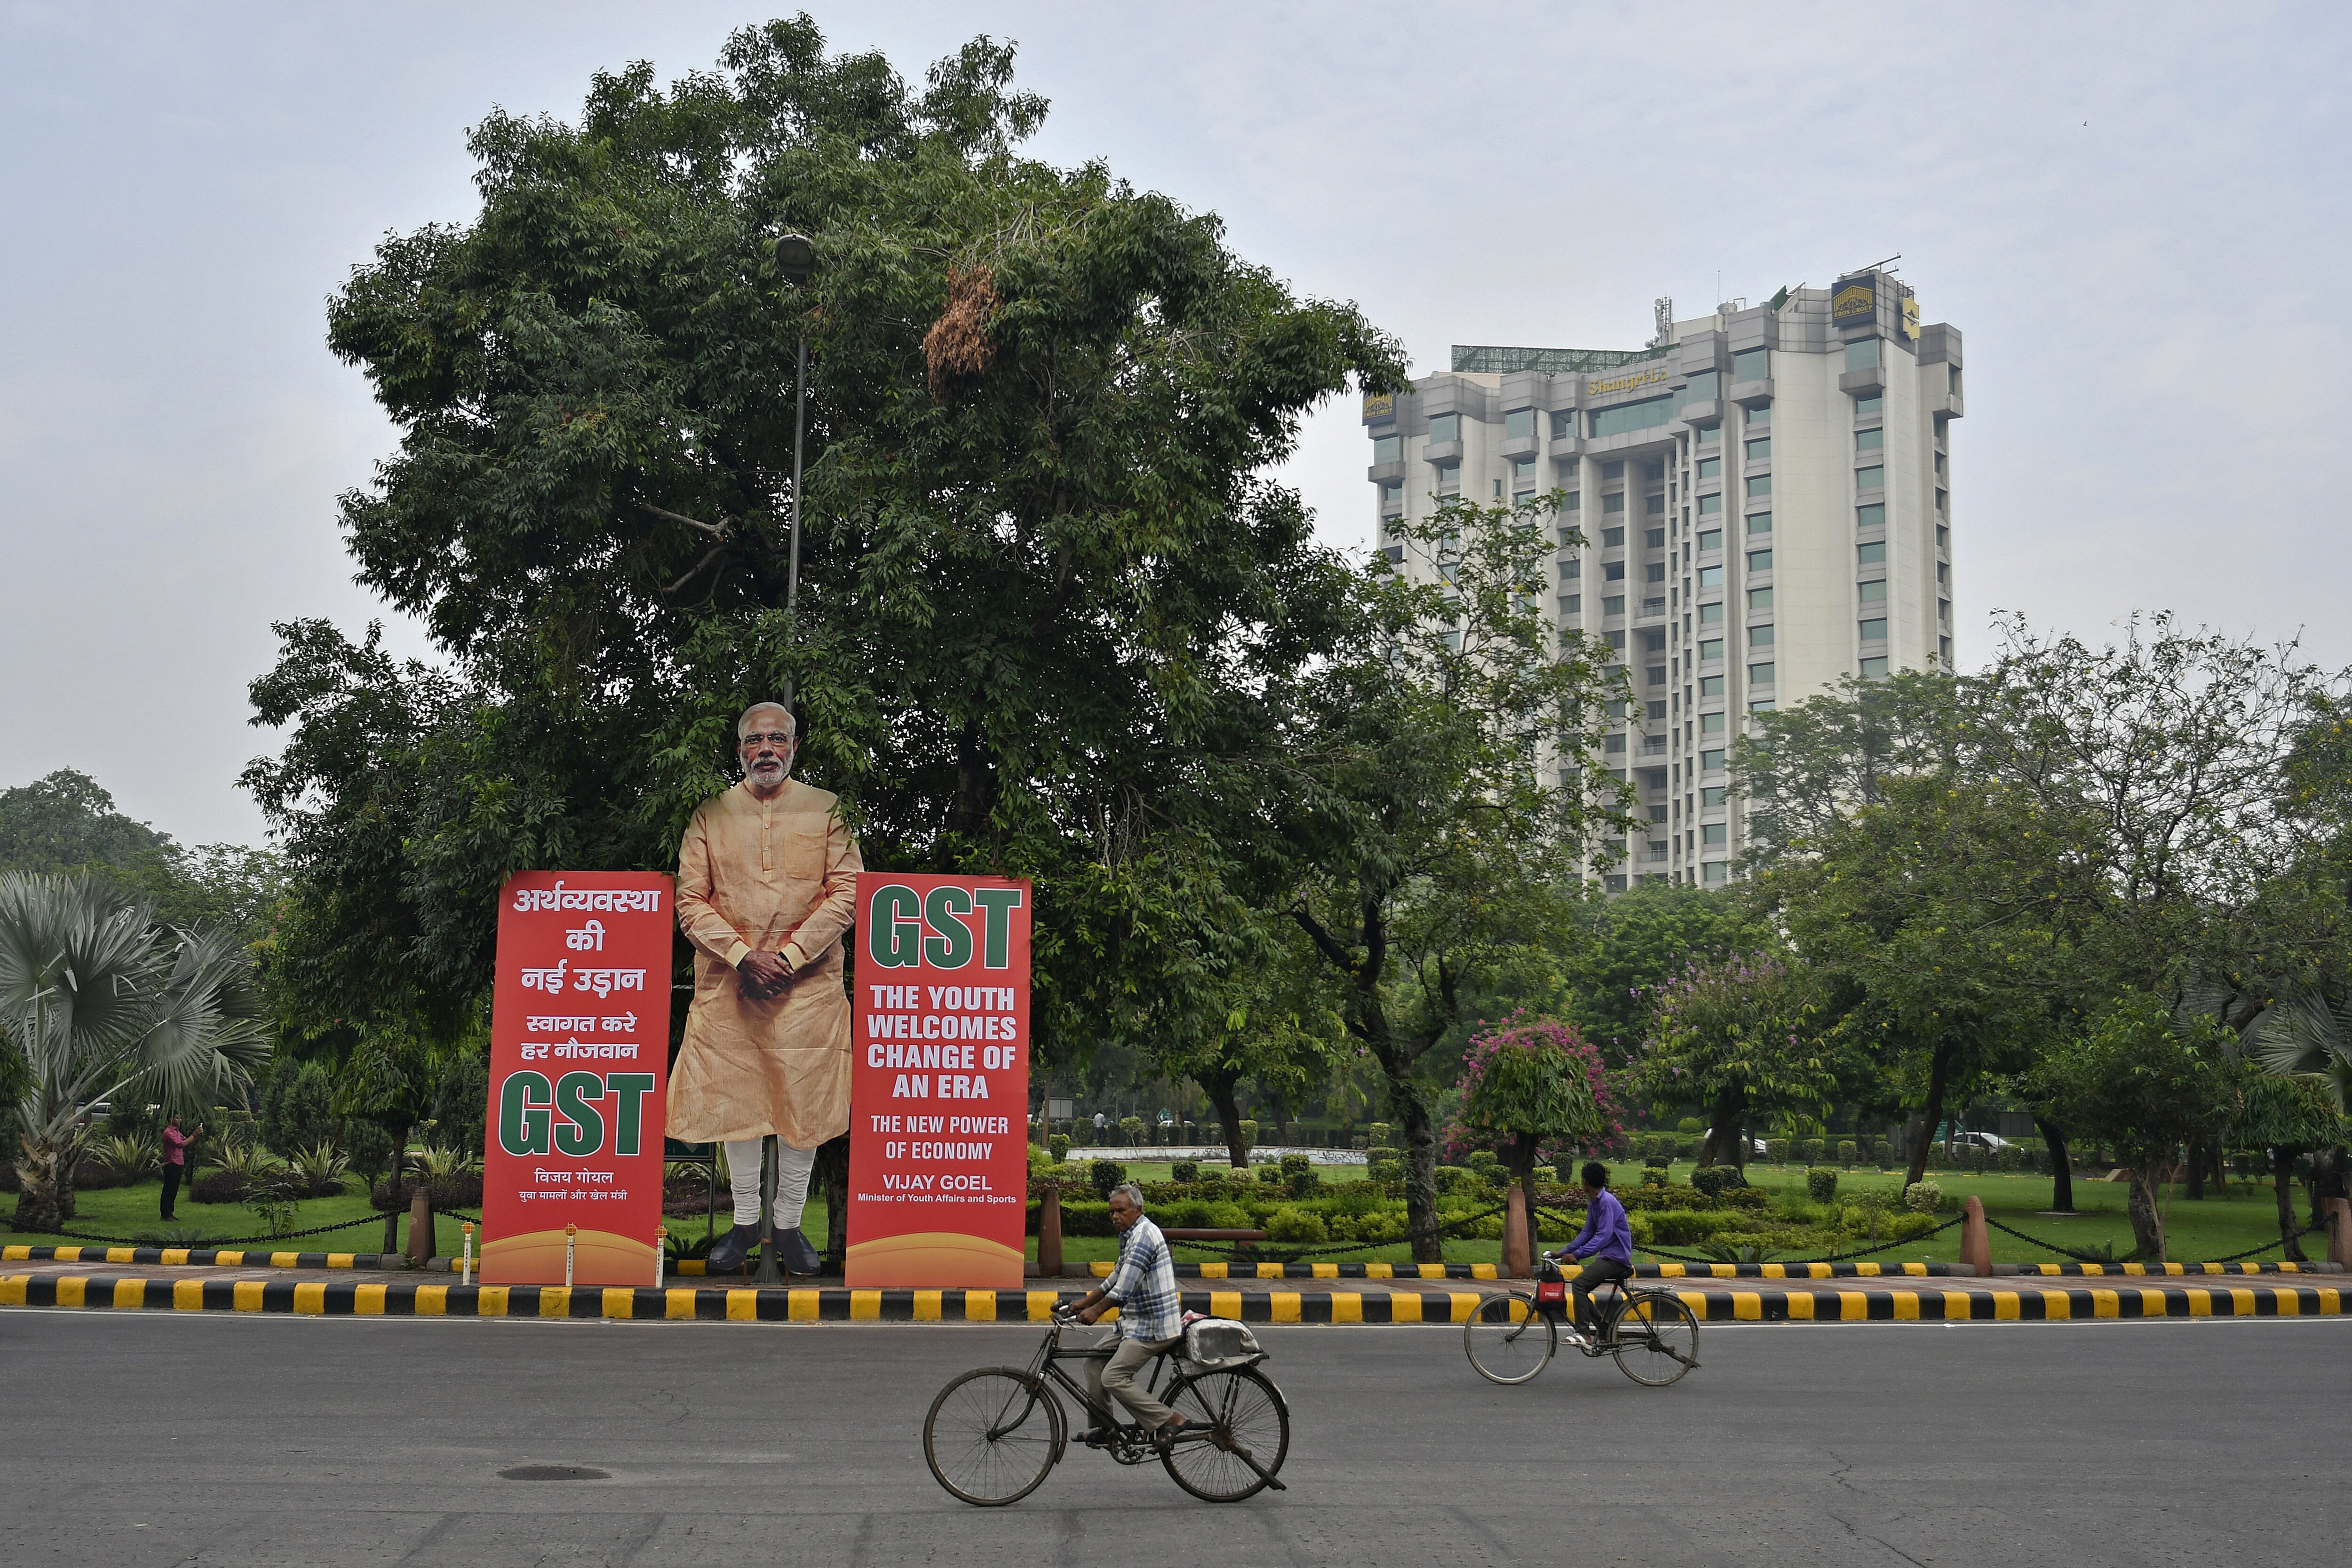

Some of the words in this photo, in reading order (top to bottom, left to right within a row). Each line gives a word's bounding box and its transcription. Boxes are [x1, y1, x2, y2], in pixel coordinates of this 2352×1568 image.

[1851, 305, 1872, 314] GROUP
[1588, 369, 1668, 395] Shangri-La
[513, 880, 661, 912] अर्थव्यवस्था
[565, 919, 606, 951] की
[869, 884, 1023, 970] GST
[521, 959, 568, 994] नई
[573, 969, 646, 999] उड़ान
[870, 985, 919, 1009] THE
[927, 986, 1014, 1011] YOUTH
[526, 1016, 597, 1032] स्वागत
[601, 1011, 638, 1032] करे
[867, 1014, 1016, 1040] WELCOMES
[520, 1043, 551, 1060] हर
[554, 1037, 640, 1059] नौजवान
[868, 1044, 975, 1069] CHANGE
[983, 1045, 1016, 1069] OF
[892, 1074, 929, 1098] AN
[938, 1075, 989, 1099] ERA
[498, 1070, 655, 1157] GST
[871, 1115, 901, 1132] THE
[906, 1116, 944, 1133] NEW
[950, 1116, 1008, 1134] POWER
[886, 1141, 906, 1159] OF
[912, 1141, 993, 1160] ECONOMY
[534, 1167, 572, 1183] विजय
[575, 1167, 614, 1184] गोयल
[882, 1174, 935, 1189] VIJAY
[940, 1175, 992, 1190] GOEL
[518, 1191, 537, 1203] युवा
[538, 1189, 567, 1200] मामलों
[570, 1188, 588, 1200] और
[589, 1189, 608, 1200] खेल
[610, 1189, 628, 1200] मंत्री
[858, 1193, 894, 1202] Minister
[907, 1194, 933, 1202] Youth
[986, 1195, 1016, 1204] Sports
